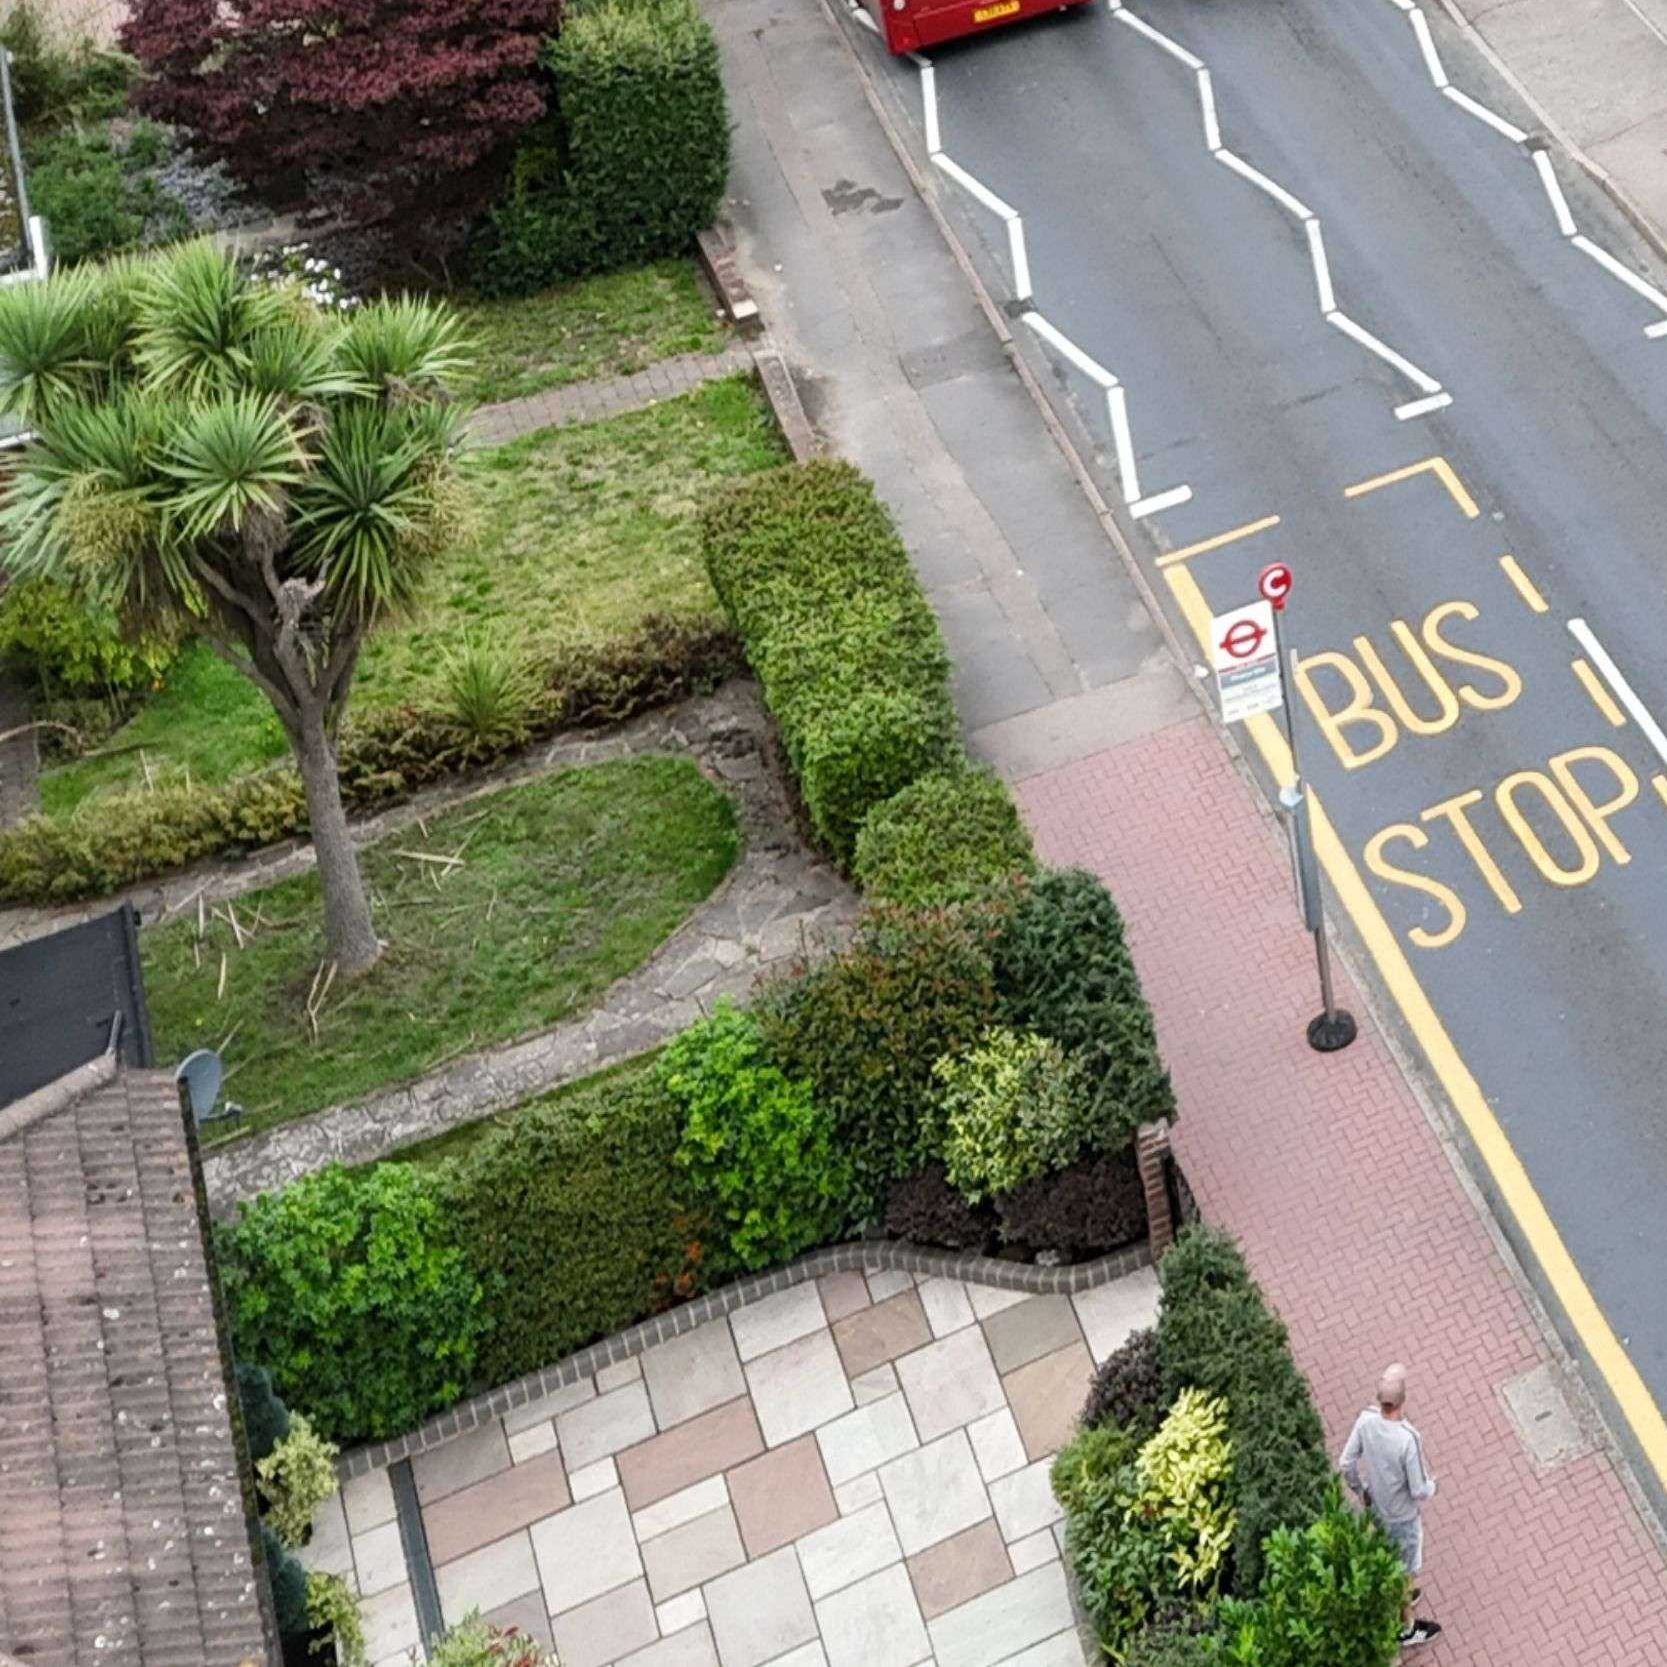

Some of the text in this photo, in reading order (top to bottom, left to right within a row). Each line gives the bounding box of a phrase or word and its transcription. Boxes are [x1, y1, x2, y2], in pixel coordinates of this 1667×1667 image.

[1263, 569, 1287, 597] C
[1293, 601, 1522, 769] BUS
[1363, 746, 1639, 948] STOP
